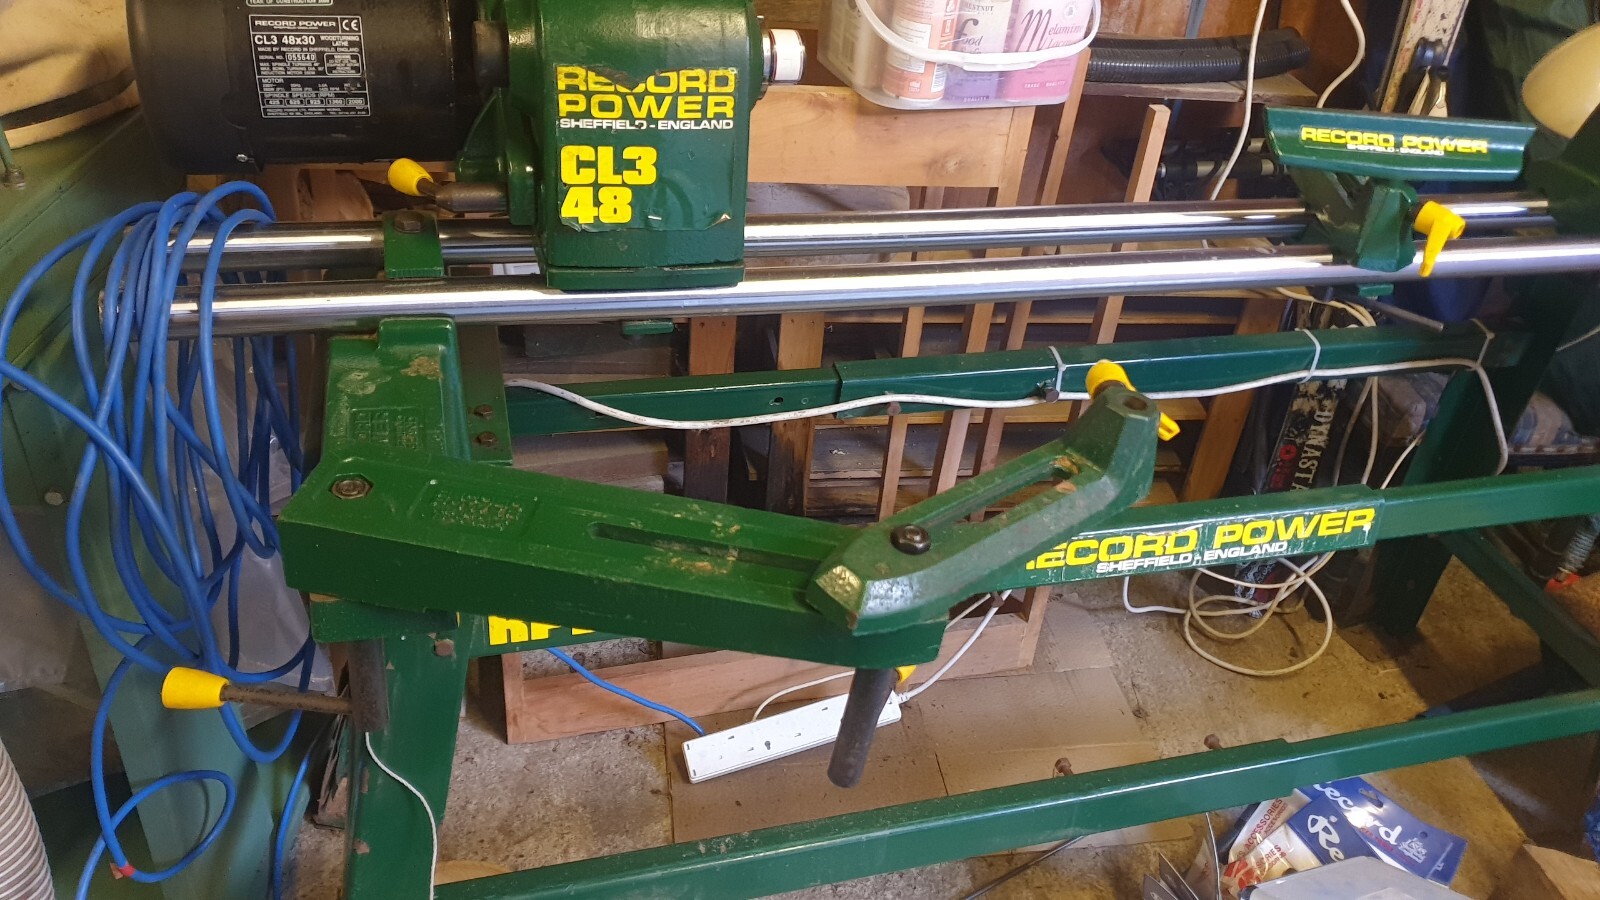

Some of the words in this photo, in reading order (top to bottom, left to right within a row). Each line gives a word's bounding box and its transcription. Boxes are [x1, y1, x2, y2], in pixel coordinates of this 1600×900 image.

[255, 35, 278, 45] CL3
[281, 35, 316, 45] 48x30
[557, 93, 735, 119] POWER
[559, 118, 647, 130] SHEFFIELD
[657, 119, 734, 130] ENGLAND
[1301, 126, 1395, 147] RECORD
[1402, 135, 1488, 154] POWER
[560, 145, 658, 185] CL3
[560, 186, 633, 224] 48
[1026, 529, 1198, 570] ECORD
[1213, 507, 1376, 549] POWER
[1095, 552, 1193, 574] SHEFFIELD
[1204, 540, 1288, 561] ENGLAND
[1245, 797, 1283, 850] ACCESSORIES
